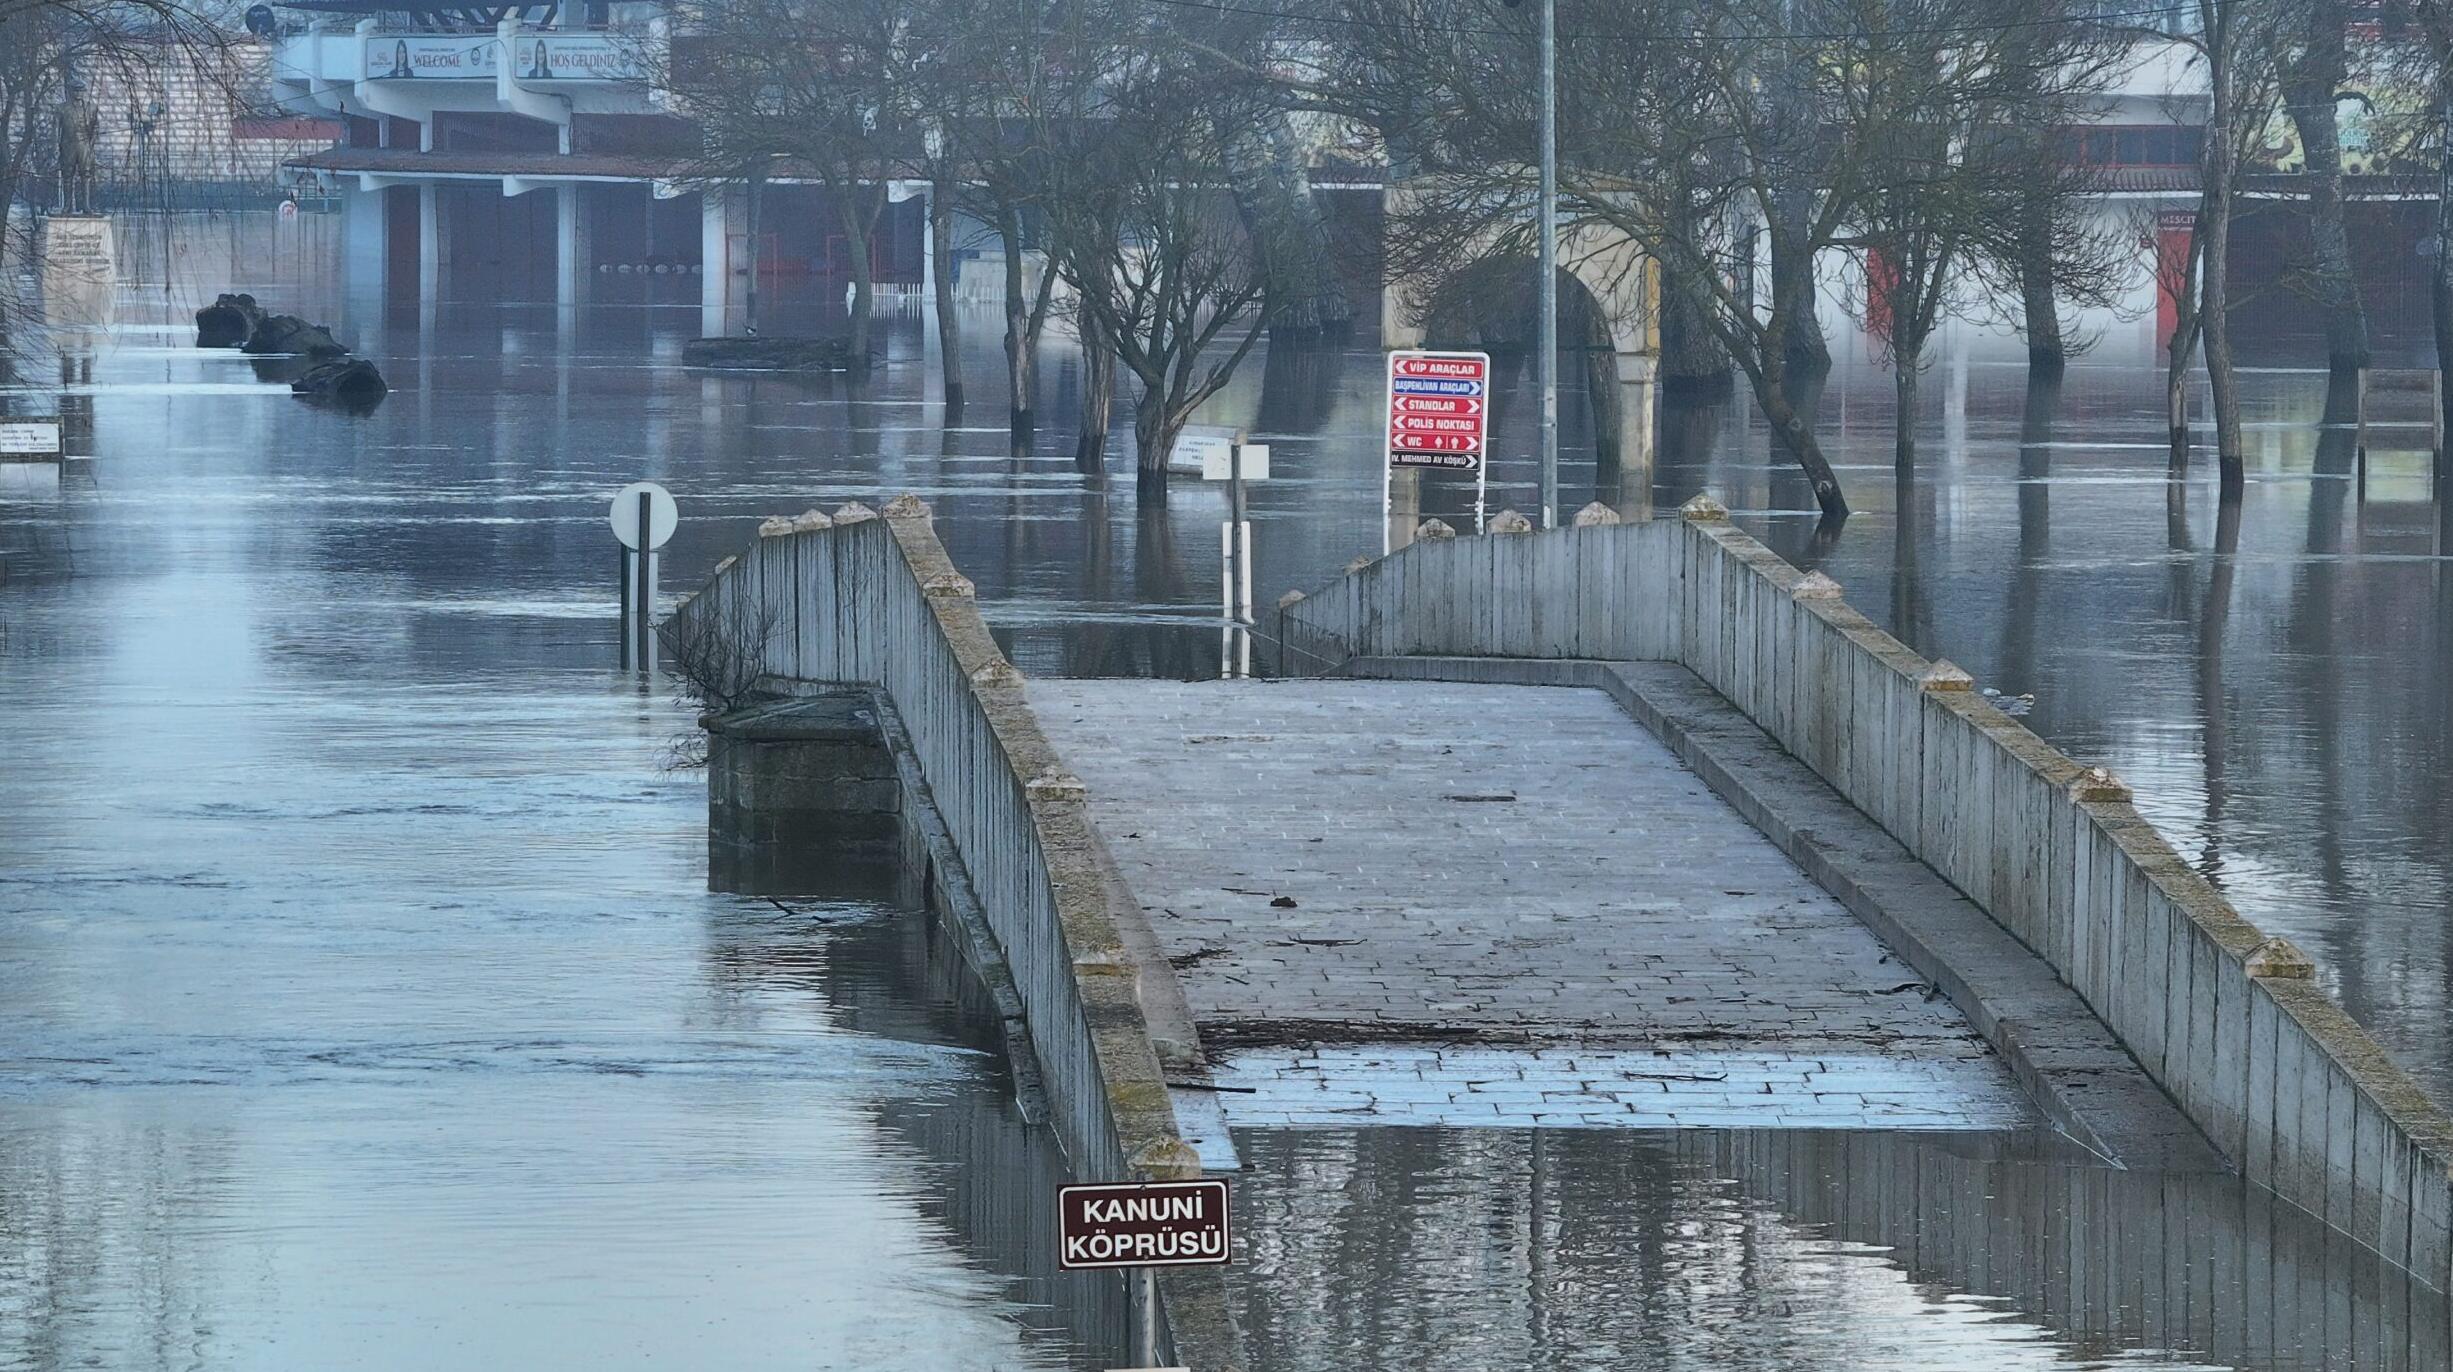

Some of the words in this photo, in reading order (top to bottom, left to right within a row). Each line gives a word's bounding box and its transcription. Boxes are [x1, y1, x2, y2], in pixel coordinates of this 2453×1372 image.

[414, 54, 461, 68] WELCOME
[551, 54, 570, 69] HOŞ
[1409, 361, 1427, 373] VİP
[1429, 363, 1475, 376] ARAÇLAR
[1395, 380, 1439, 393] BAŞPEHLİVAN
[1440, 381, 1470, 395] ARAÇLARI
[1408, 400, 1456, 412] STANDLAR
[1407, 416, 1434, 429] POLİS
[1436, 419, 1475, 431] NOKTASI
[1407, 436, 1422, 447] WC
[1401, 455, 1432, 463] MEHMED
[1433, 456, 1442, 464] AV
[1443, 455, 1467, 467] KÖŞKÜ
[1083, 1190, 1203, 1223] KANUNİ
[1067, 1224, 1221, 1259] KÖPRÜSÜ
